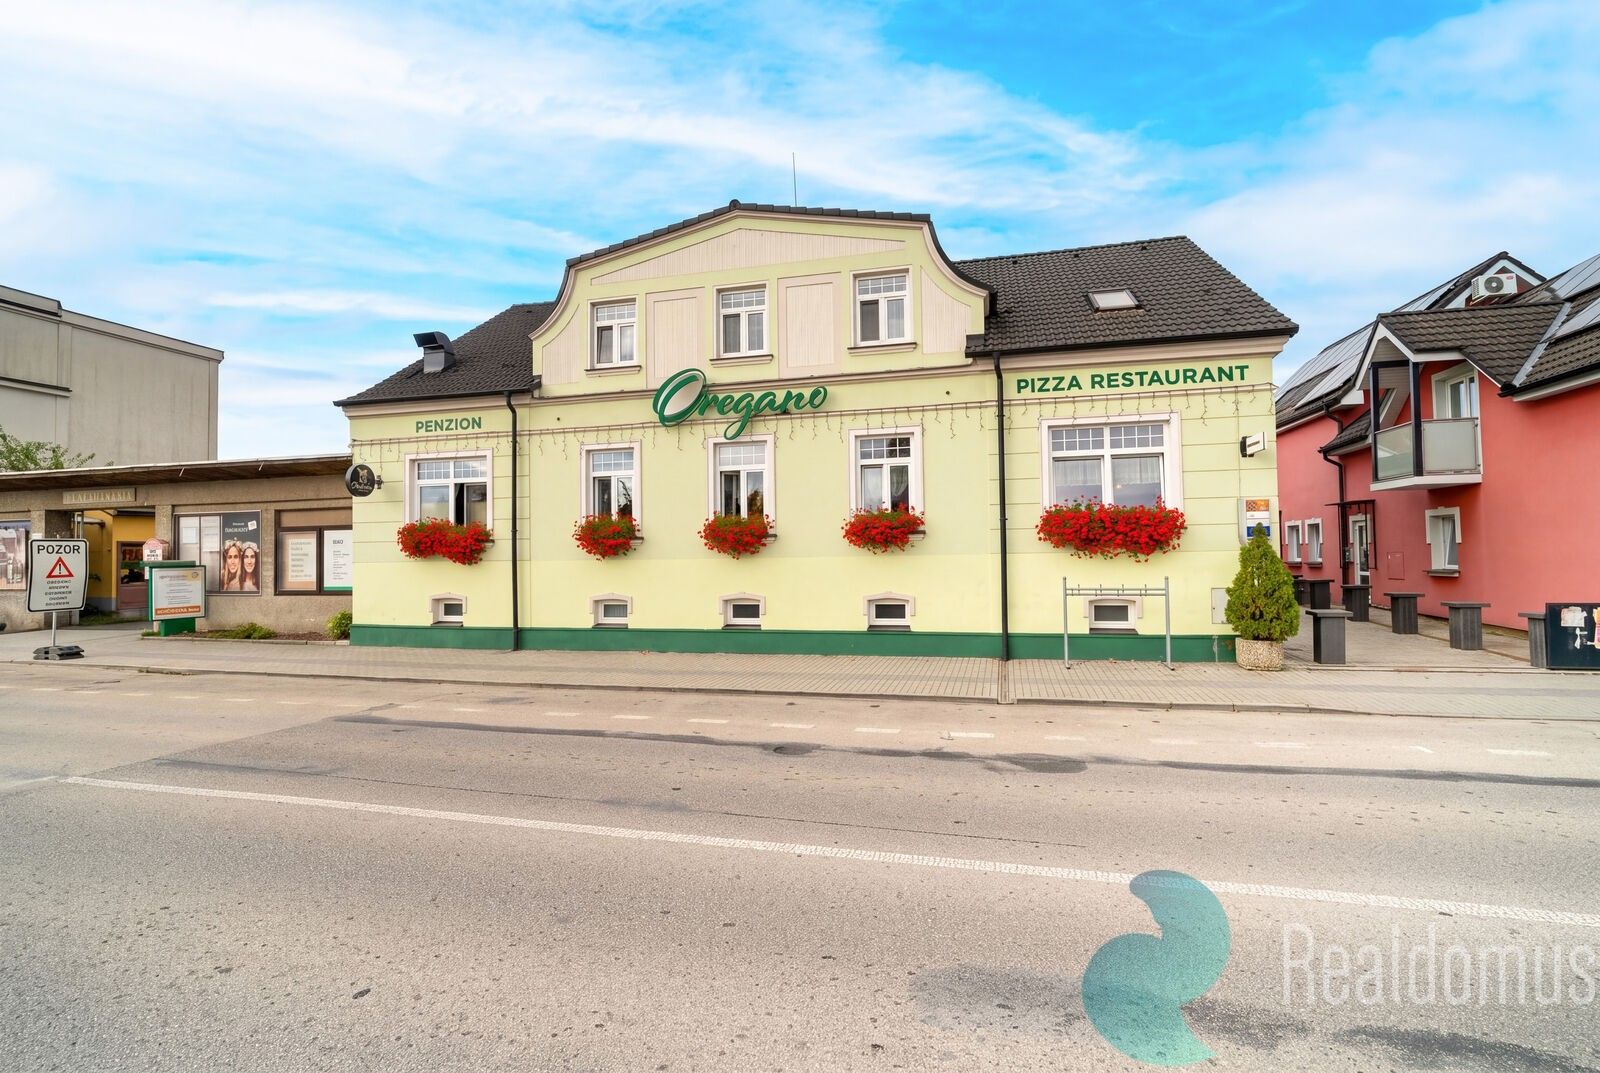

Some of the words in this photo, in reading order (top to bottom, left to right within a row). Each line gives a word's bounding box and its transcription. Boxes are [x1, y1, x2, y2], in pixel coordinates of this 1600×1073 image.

[1016, 375, 1083, 394] PIZZA
[1090, 364, 1250, 389] RESTAURANT
[652, 368, 828, 441] Oregano
[415, 416, 482, 433] PENZION
[37, 544, 81, 555] POZOR
